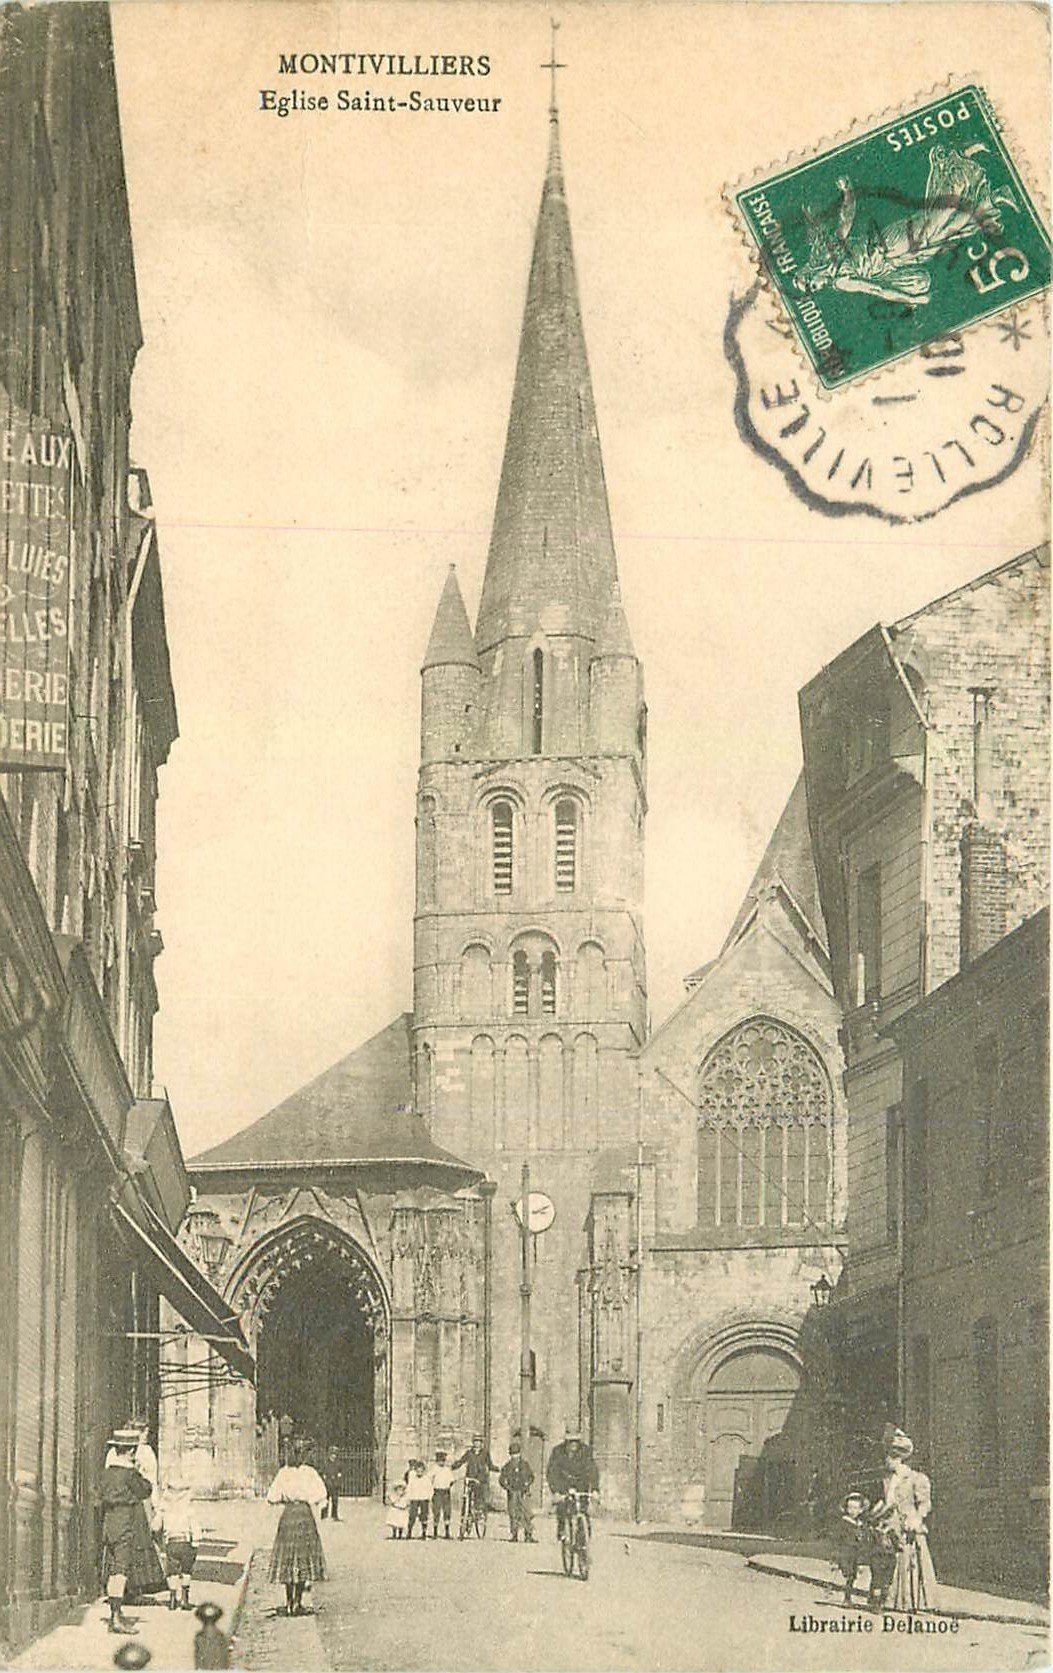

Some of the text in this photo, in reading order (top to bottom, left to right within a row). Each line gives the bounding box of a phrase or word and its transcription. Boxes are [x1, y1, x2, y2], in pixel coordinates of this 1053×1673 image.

[886, 101, 970, 153] POSTES
[2, 432, 71, 470] EAUX
[760, 378, 1026, 494] ROLLEVILLE
[1, 480, 67, 520] ETTES
[0, 668, 67, 705] ERIE
